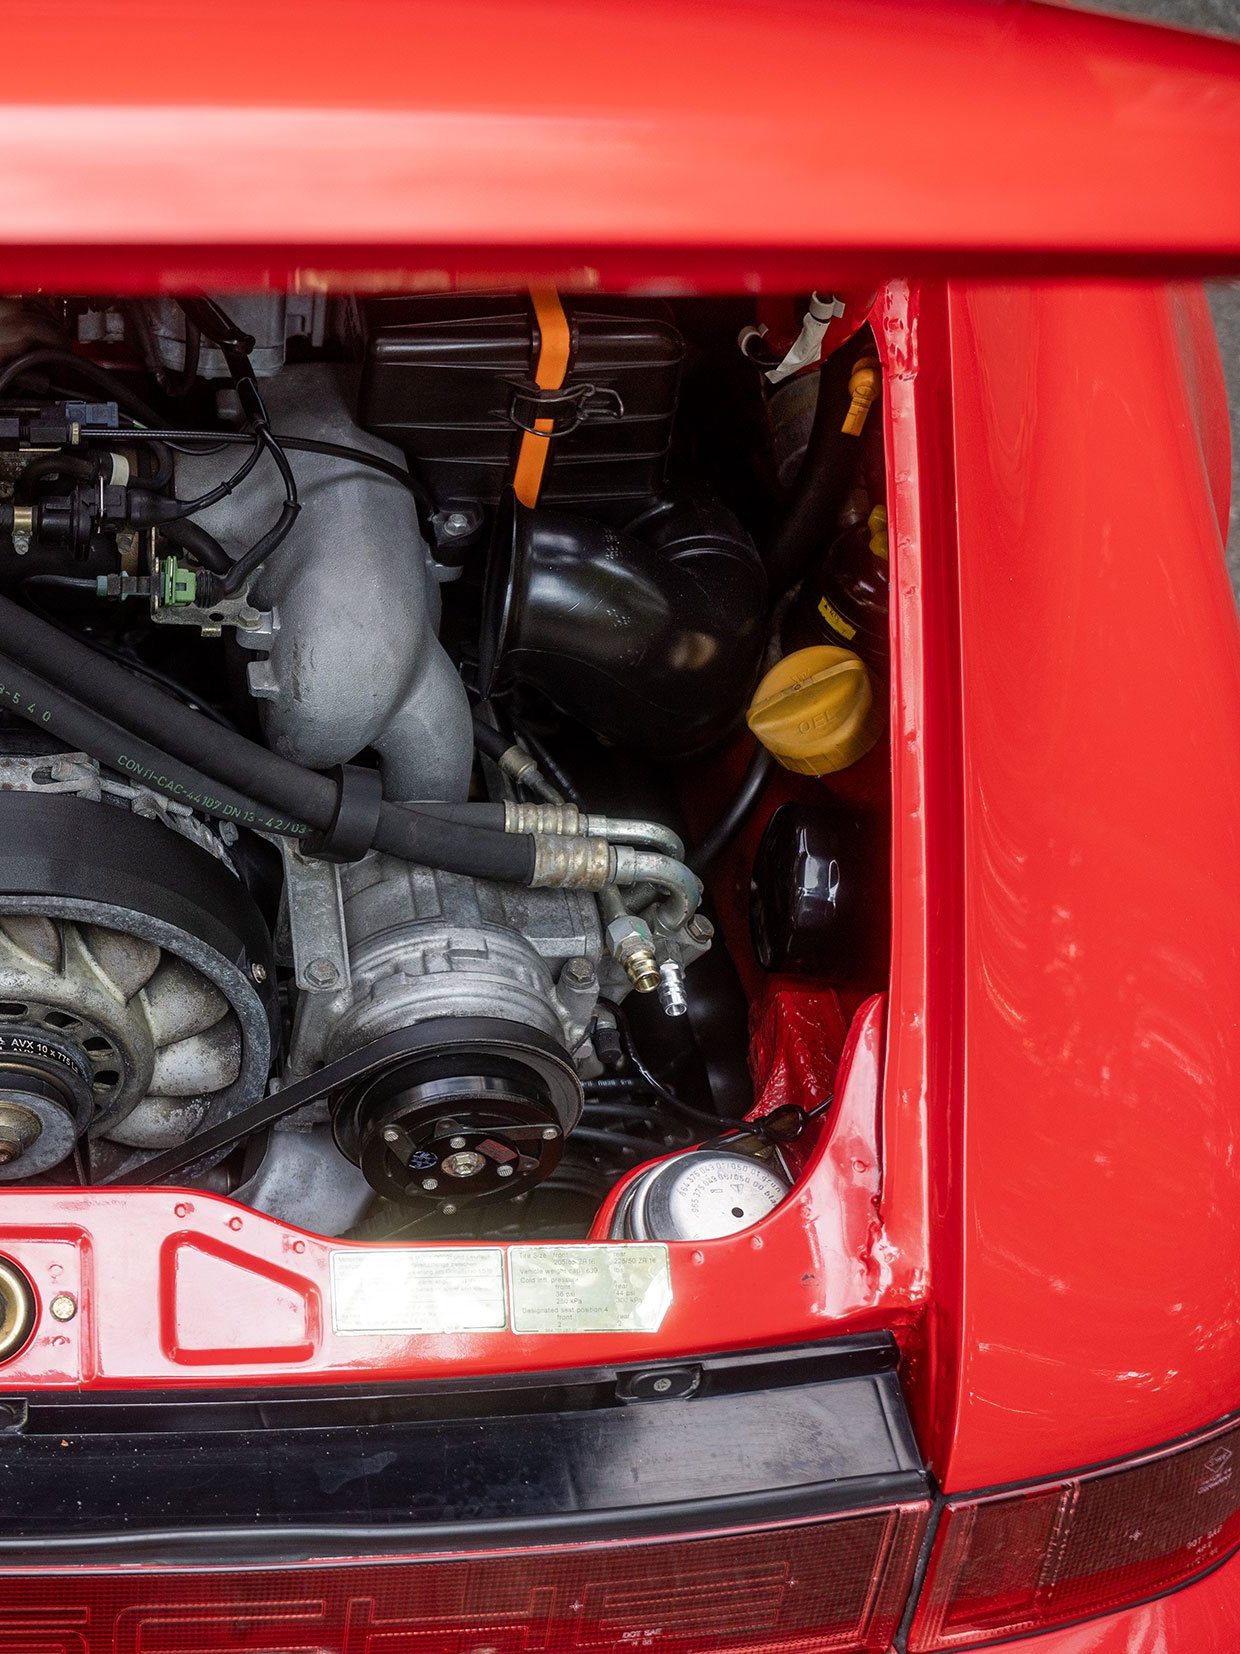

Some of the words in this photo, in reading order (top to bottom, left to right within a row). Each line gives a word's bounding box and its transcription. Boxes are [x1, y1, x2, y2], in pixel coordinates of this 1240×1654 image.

[27, 703, 36, 714] 4
[798, 711, 837, 735] OEL
[117, 754, 221, 811] CONTI-CAC-44107
[222, 805, 242, 818] DN
[243, 811, 254, 823] 13
[11, 1038, 34, 1050] AVX
[37, 1044, 48, 1054] 10
[764, 1191, 778, 1206] bla
[622, 1630, 641, 1638] DOT
